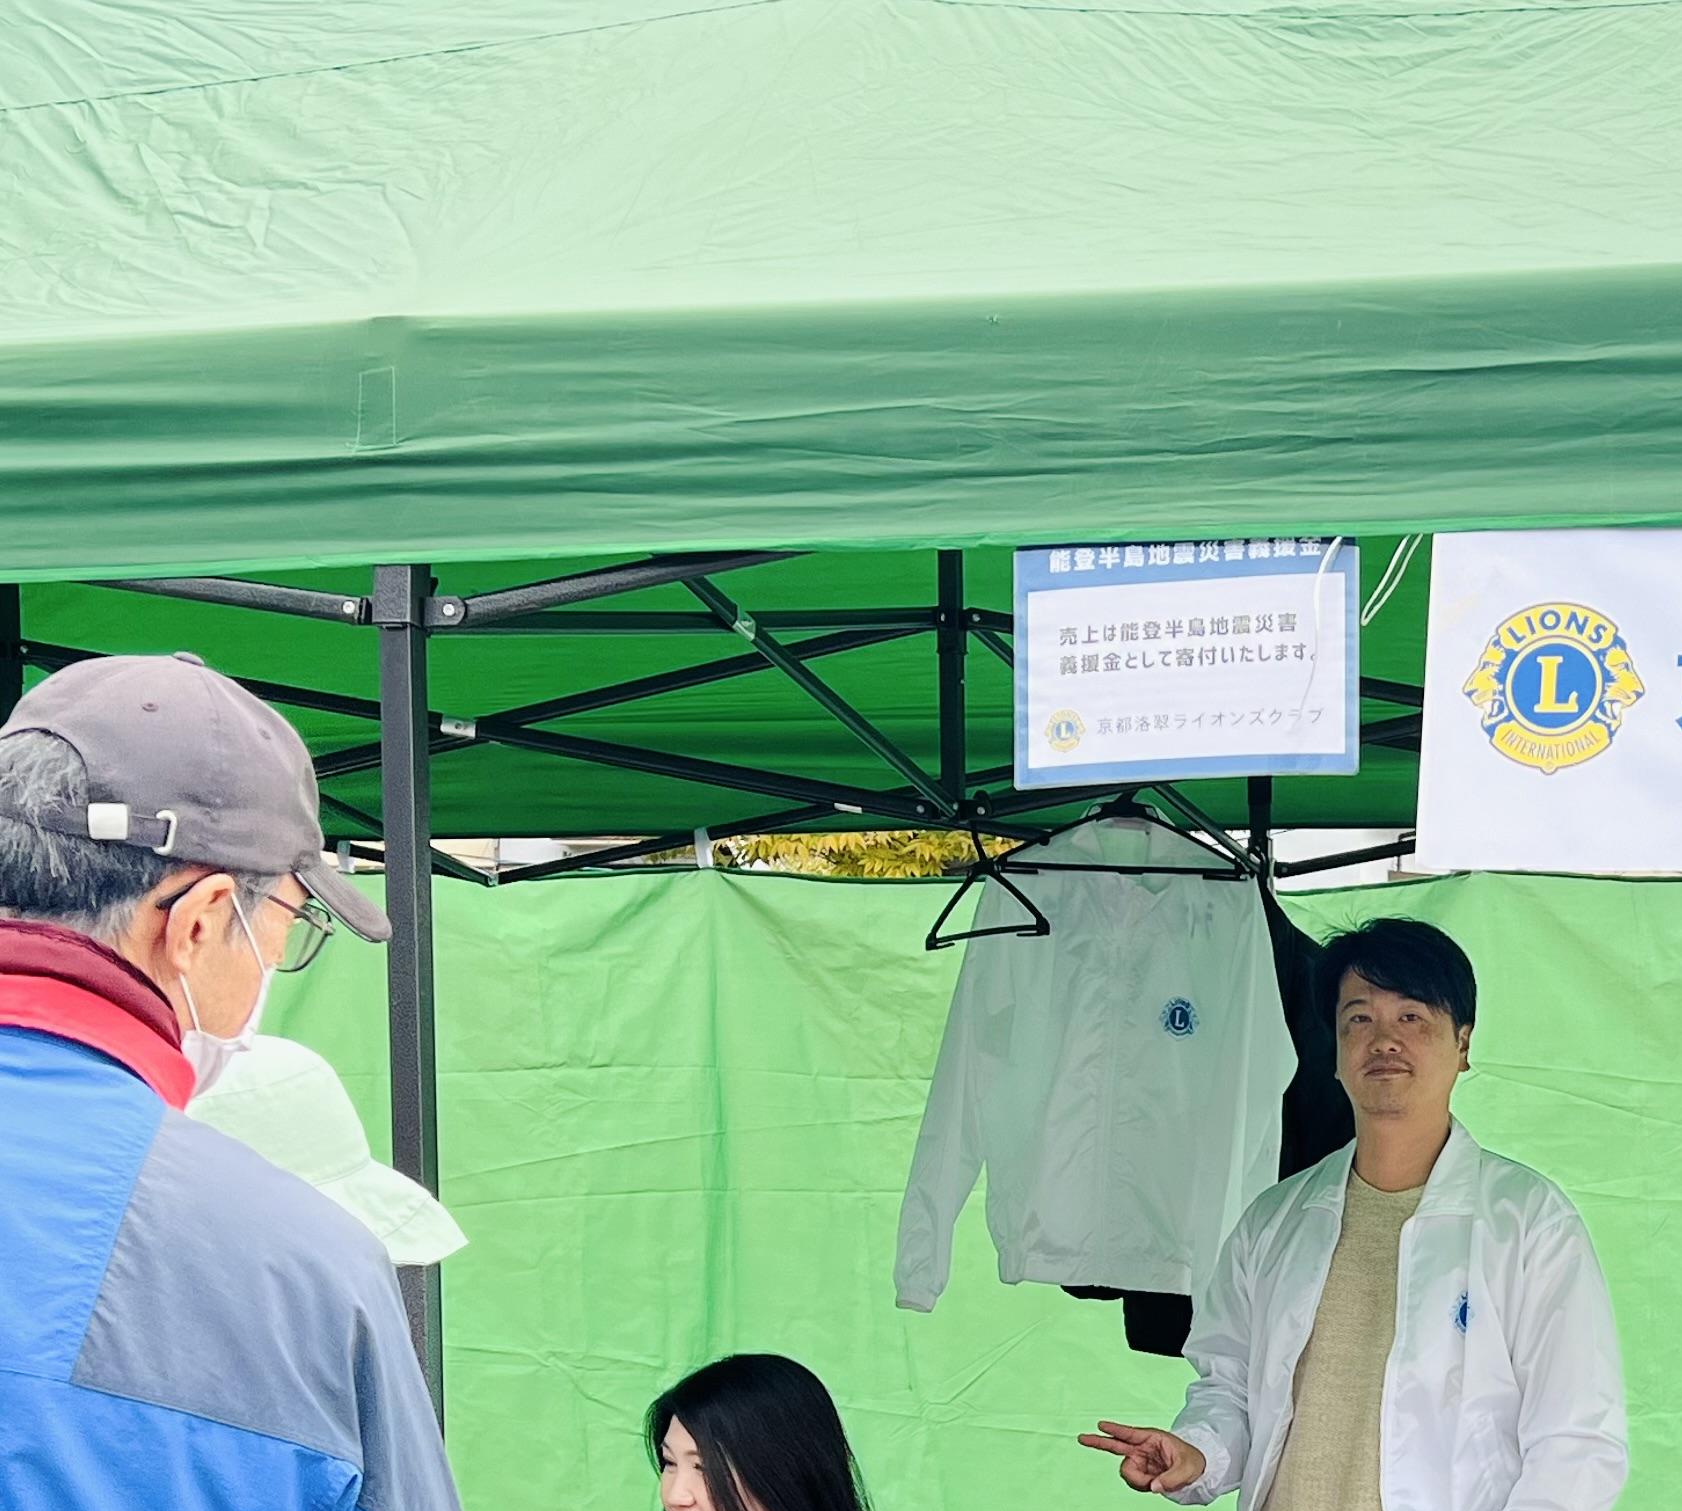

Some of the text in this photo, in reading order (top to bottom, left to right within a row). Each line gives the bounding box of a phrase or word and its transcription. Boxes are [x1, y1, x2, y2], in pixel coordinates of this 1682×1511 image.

[1059, 612, 1298, 646] 売上は能登半島地震災害
[1506, 609, 1608, 645] LIONS
[1059, 642, 1318, 676] 義援金として寄付いたします。
[1533, 655, 1580, 714] L
[1501, 728, 1602, 761] INTERNATIONAL
[1174, 1009, 1185, 1028] L
